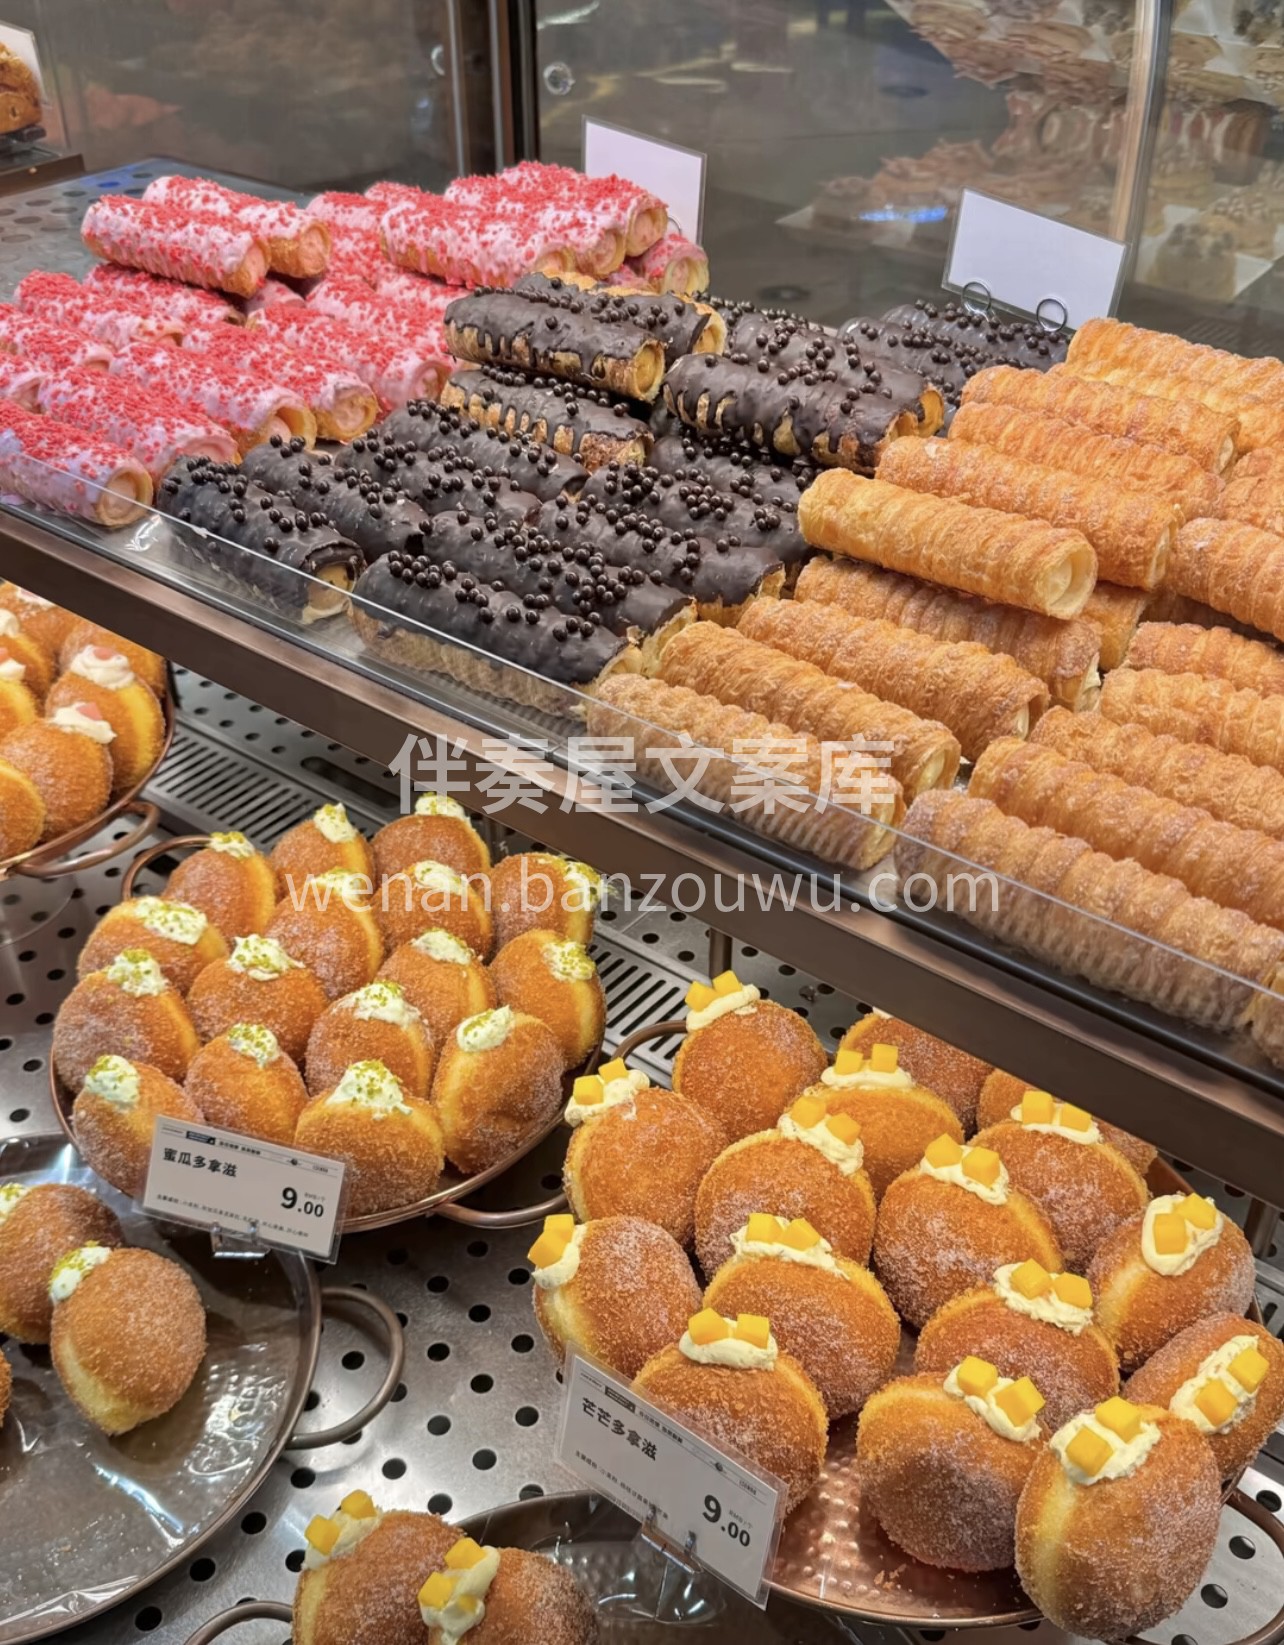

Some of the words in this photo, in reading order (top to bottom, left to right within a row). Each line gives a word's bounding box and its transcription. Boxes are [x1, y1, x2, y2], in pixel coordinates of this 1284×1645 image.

[163, 1147, 238, 1178] 蜜瓜多拿滋
[280, 1187, 324, 1218] 9.00
[581, 1397, 658, 1461] 芒芒多拿滋
[702, 1494, 751, 1547] 9.00
